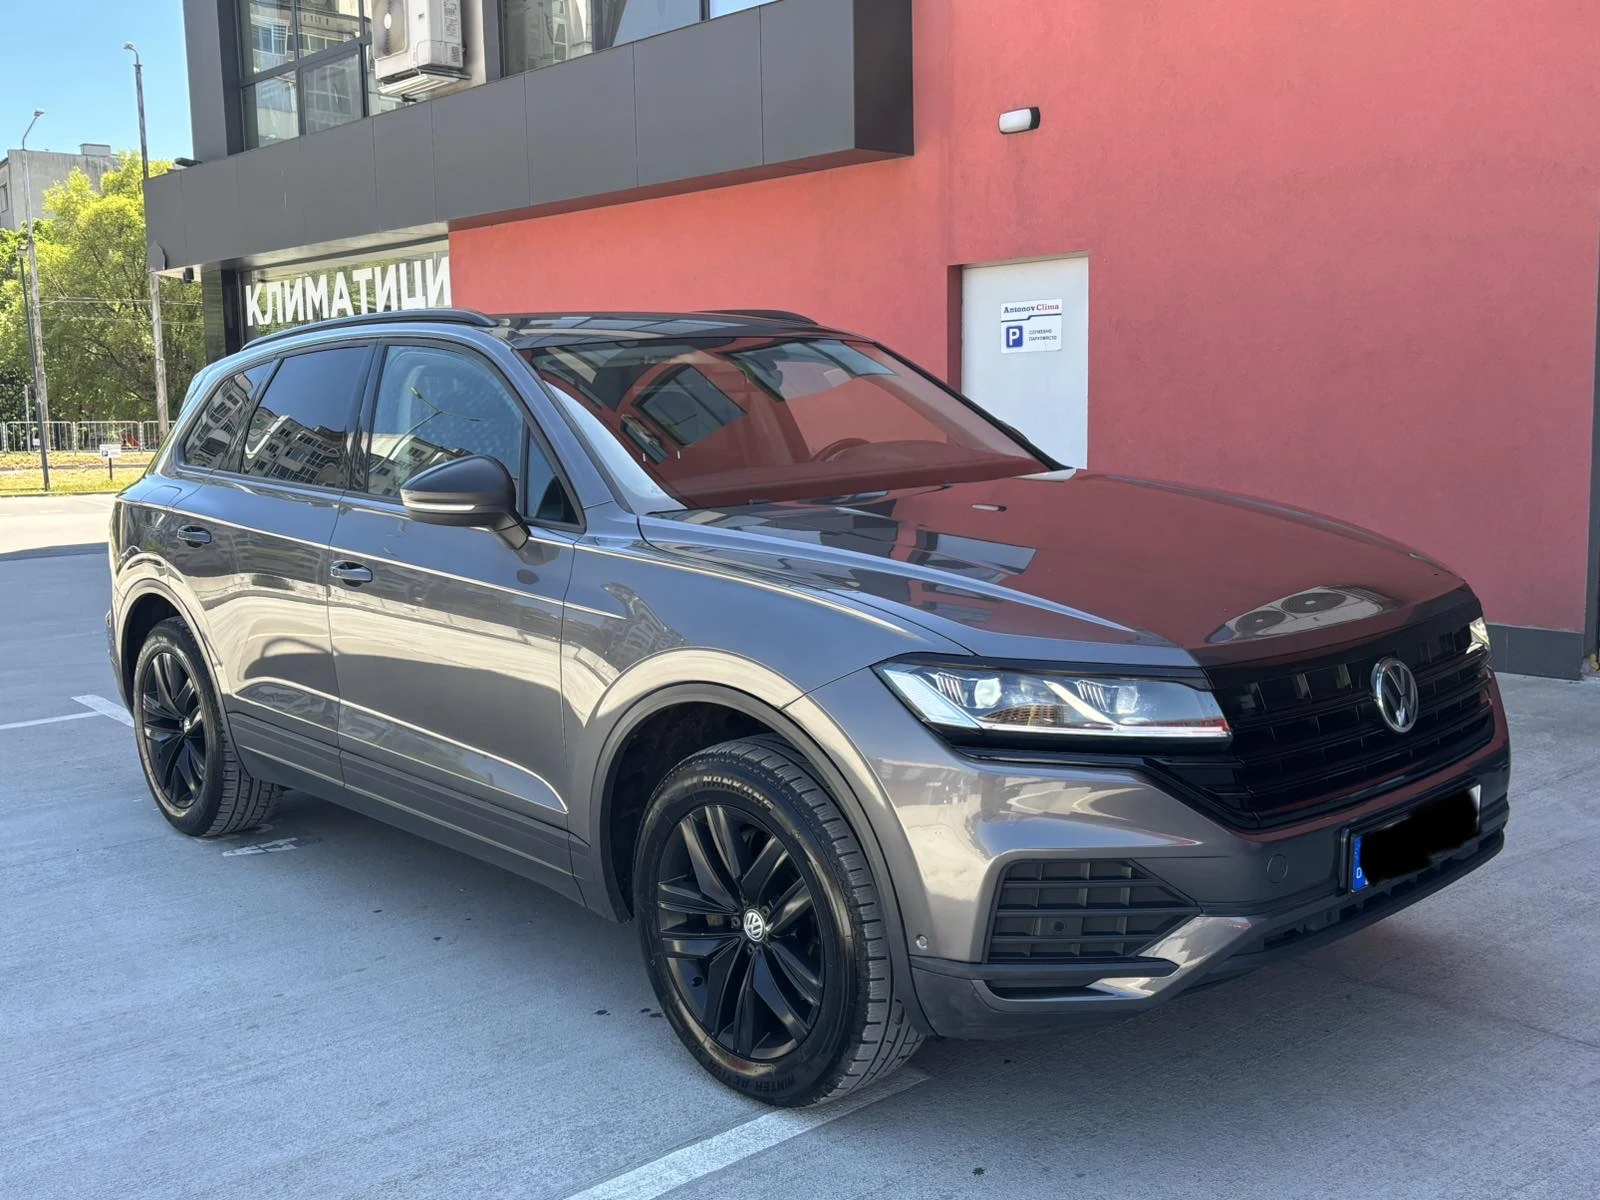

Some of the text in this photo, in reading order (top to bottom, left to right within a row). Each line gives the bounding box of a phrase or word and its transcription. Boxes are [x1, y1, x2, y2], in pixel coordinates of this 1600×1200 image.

[245, 256, 452, 326] КЛИМАТИЦИ
[1003, 306, 1036, 314] Antonov
[1008, 328, 1020, 347] P
[1356, 866, 1363, 879] D
